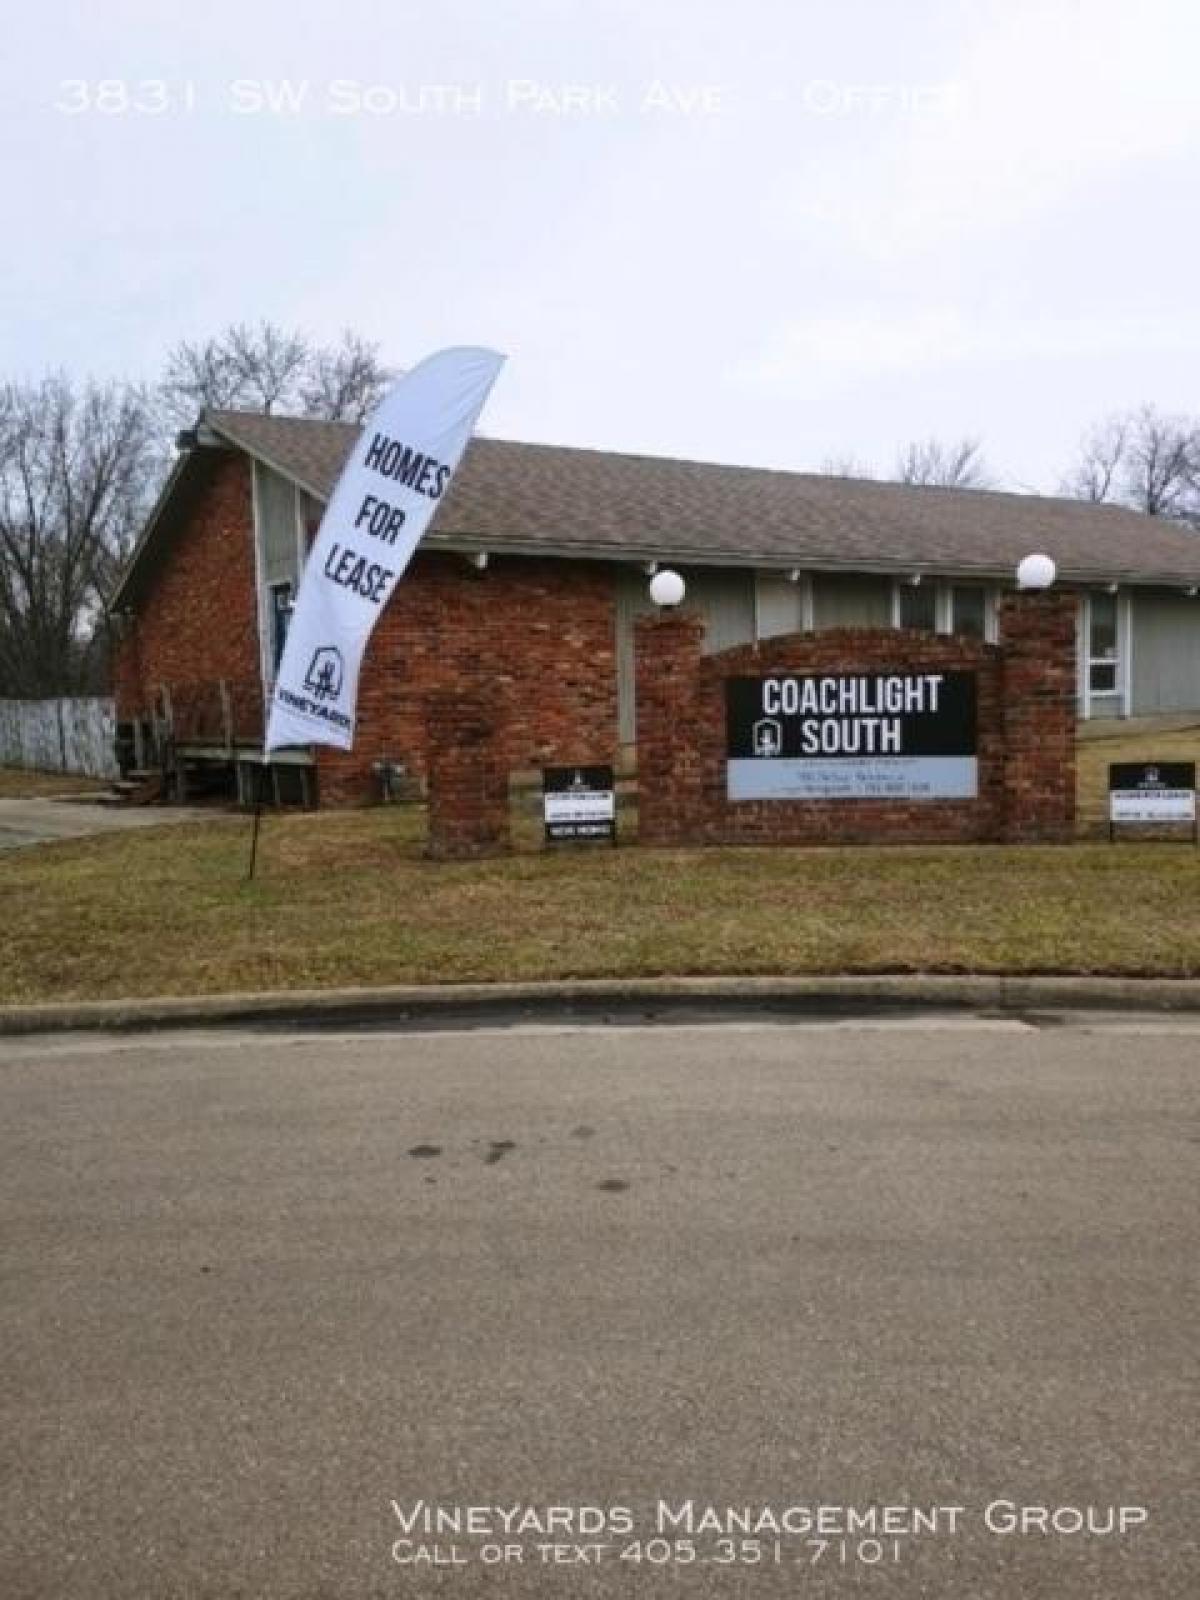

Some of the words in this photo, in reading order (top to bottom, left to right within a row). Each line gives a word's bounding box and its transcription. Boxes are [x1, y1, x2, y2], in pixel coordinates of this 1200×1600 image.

[364, 432, 450, 499] HOMES
[354, 494, 405, 545] FOR
[324, 543, 395, 603] LEASE
[762, 674, 943, 715] COACHLIGHT
[801, 717, 901, 753] SOUTH
